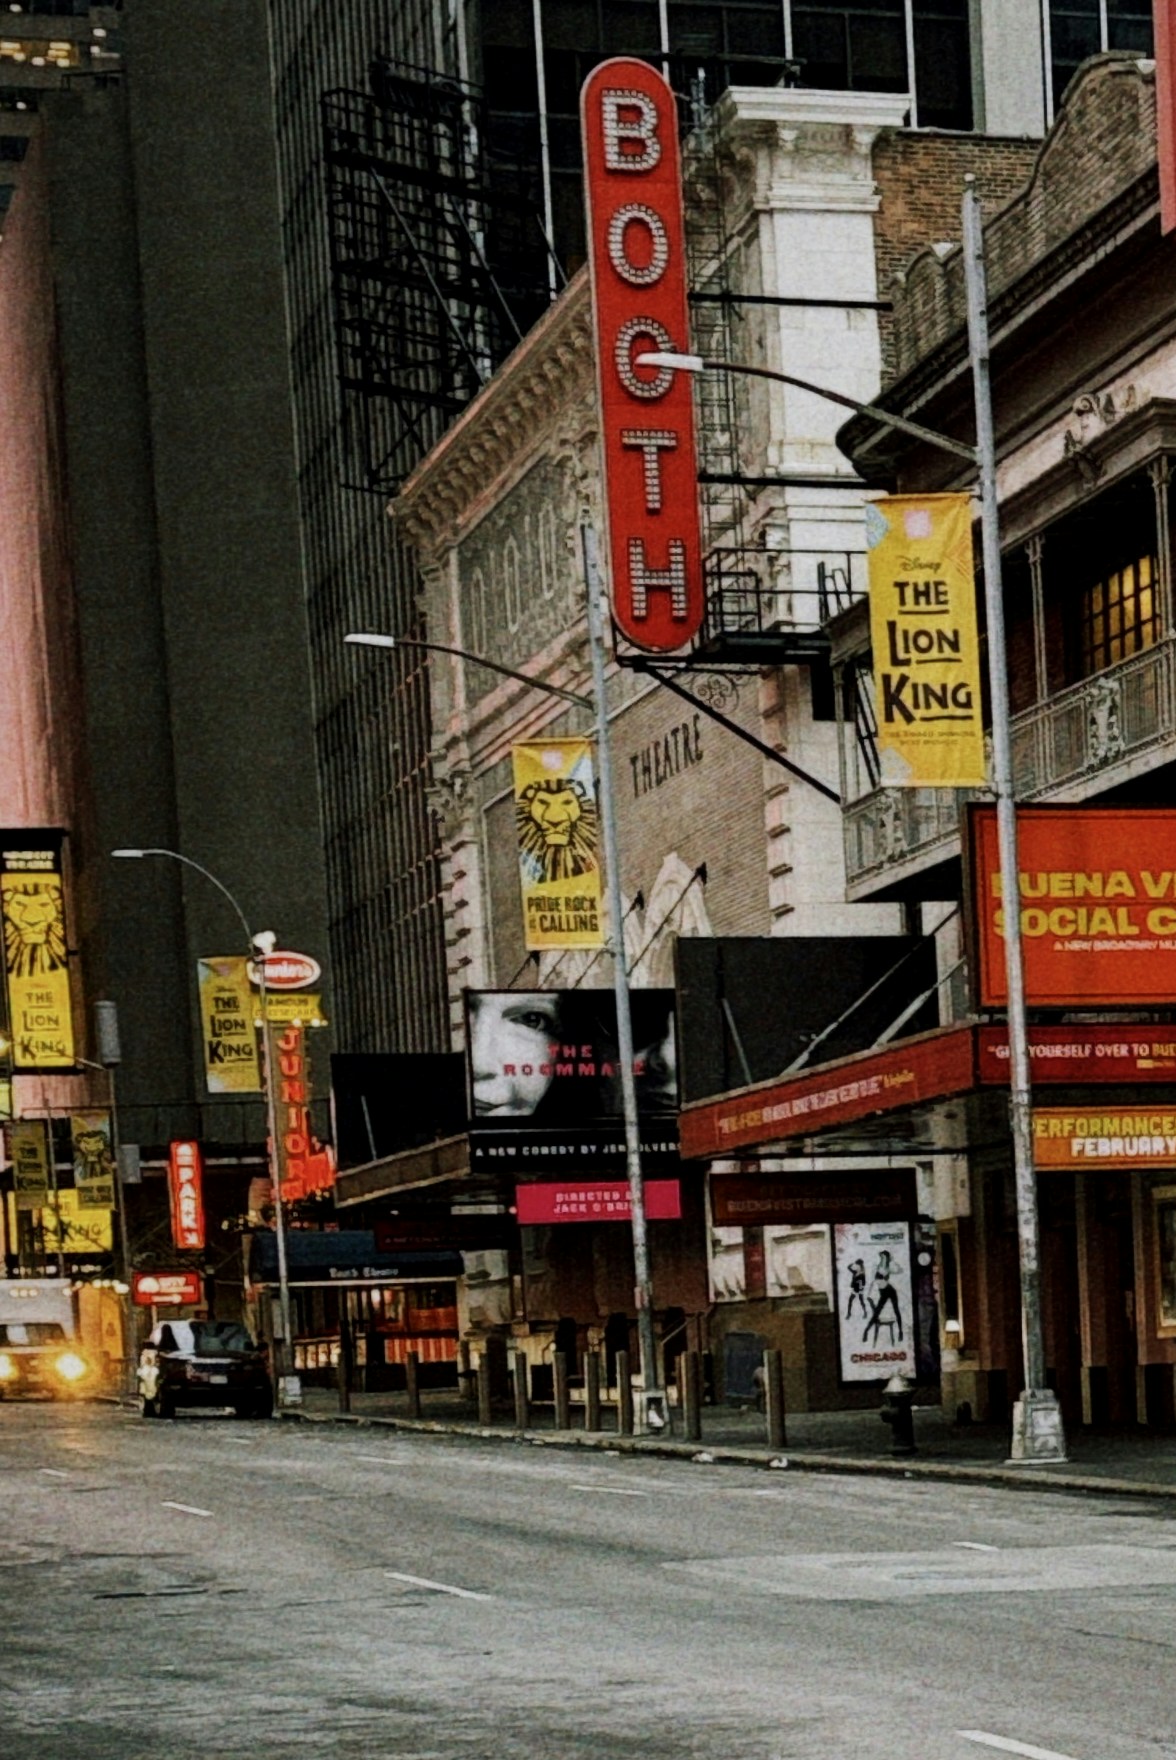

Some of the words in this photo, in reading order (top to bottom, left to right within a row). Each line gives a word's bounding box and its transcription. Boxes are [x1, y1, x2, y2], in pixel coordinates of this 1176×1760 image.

[602, 88, 690, 620] BOOTH
[893, 581, 949, 606] THE
[630, 713, 703, 798] THEATRE
[527, 895, 562, 913] PRIDE
[565, 896, 597, 912] ROCK
[539, 913, 600, 933] CALLING
[26, 992, 54, 1003] THE
[214, 997, 240, 1010] THE
[547, 1045, 593, 1058] THE
[1029, 1045, 1092, 1058] YOURSELF
[1095, 1044, 1129, 1057] OVER
[1132, 1044, 1150, 1057] TO
[475, 1148, 484, 1157] A
[489, 1147, 517, 1157] NEW
[522, 1146, 575, 1156] COMEDY
[556, 1191, 621, 1203] DIRECTED
[553, 1203, 588, 1214] JACK
[851, 1352, 907, 1364] CHICAGO
